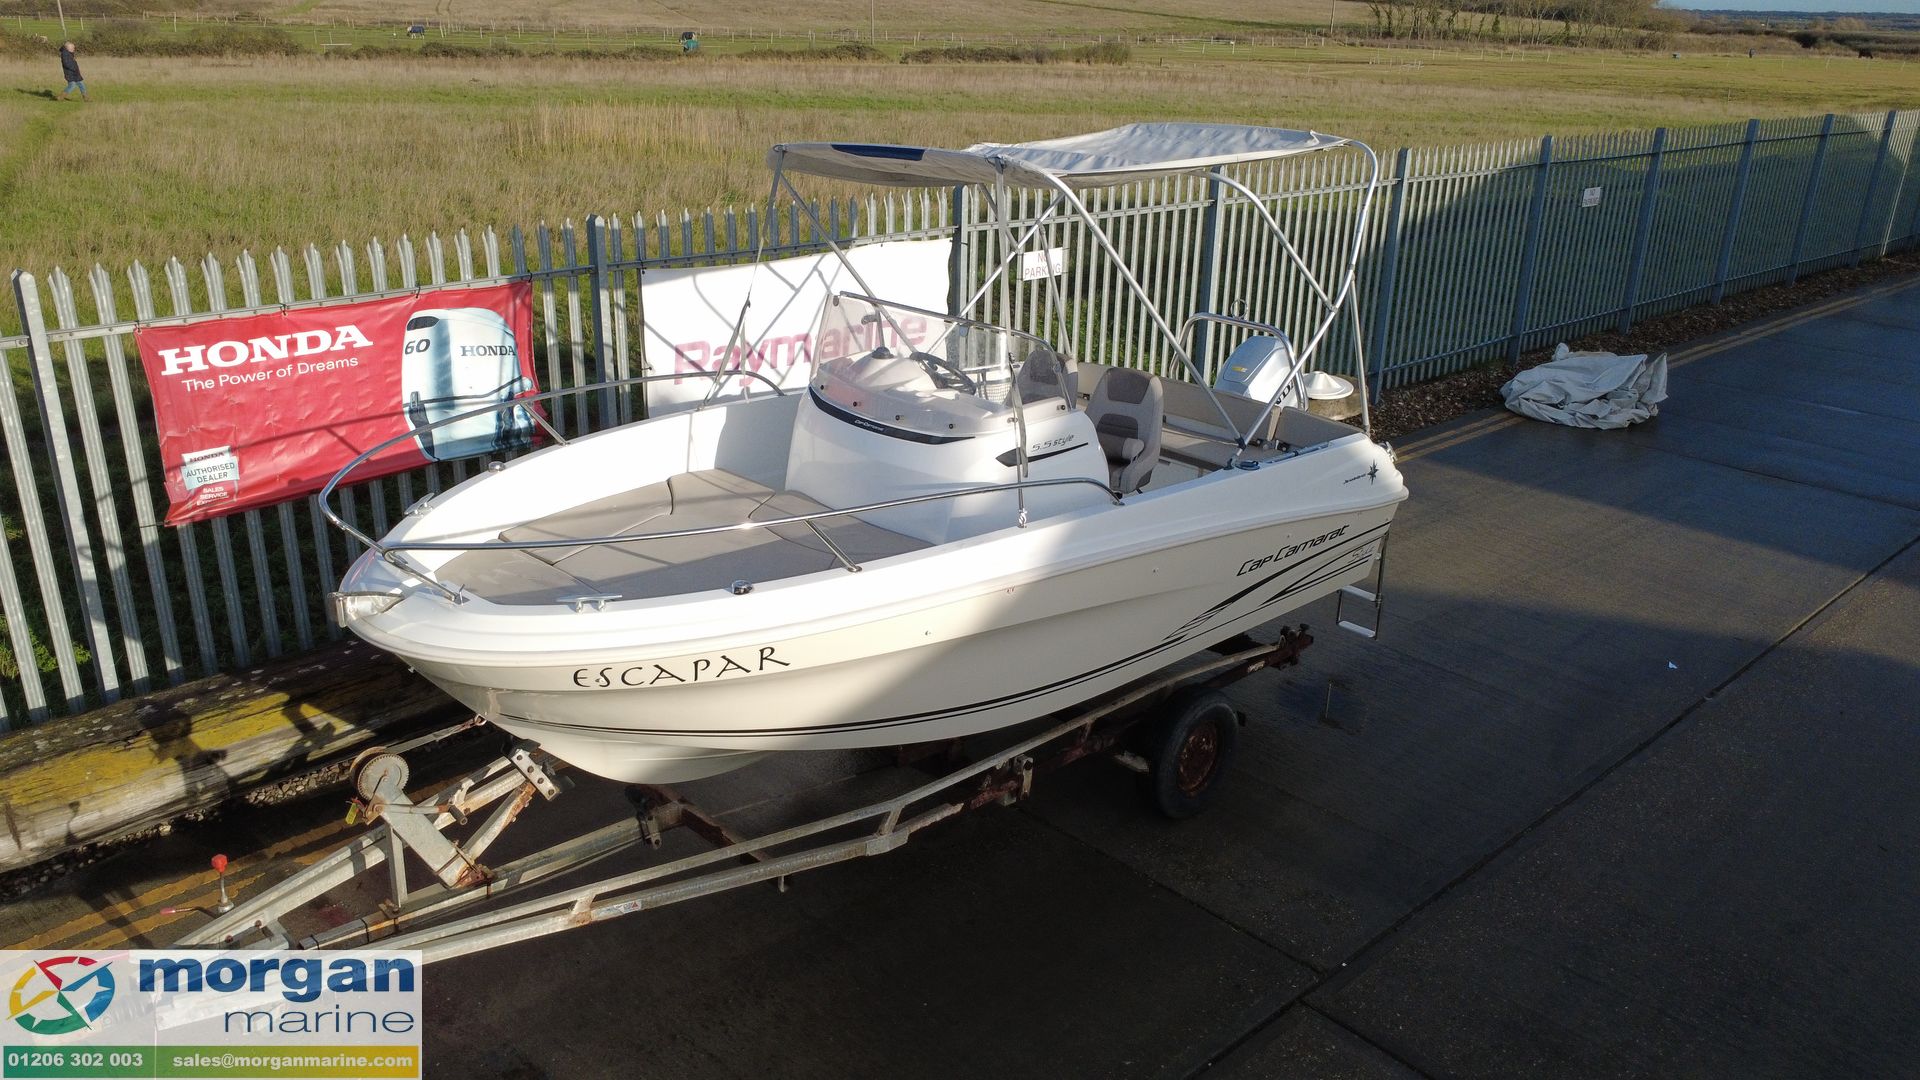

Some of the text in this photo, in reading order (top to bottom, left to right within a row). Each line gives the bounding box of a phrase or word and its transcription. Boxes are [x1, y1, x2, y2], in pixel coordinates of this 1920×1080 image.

[158, 324, 374, 376] HONDA
[404, 338, 431, 355] 60
[460, 345, 516, 357] HONDA
[673, 317, 927, 387] Raymarine
[181, 356, 359, 392] The Power of Dreams
[1031, 440, 1052, 452] 5.5
[186, 462, 235, 477] AUTHORISED
[196, 472, 228, 483] DEALER
[199, 492, 228, 500] SERVICE
[203, 486, 225, 494] SALES
[1274, 524, 1350, 562] Camarat
[573, 646, 791, 688] ESCAPAR
